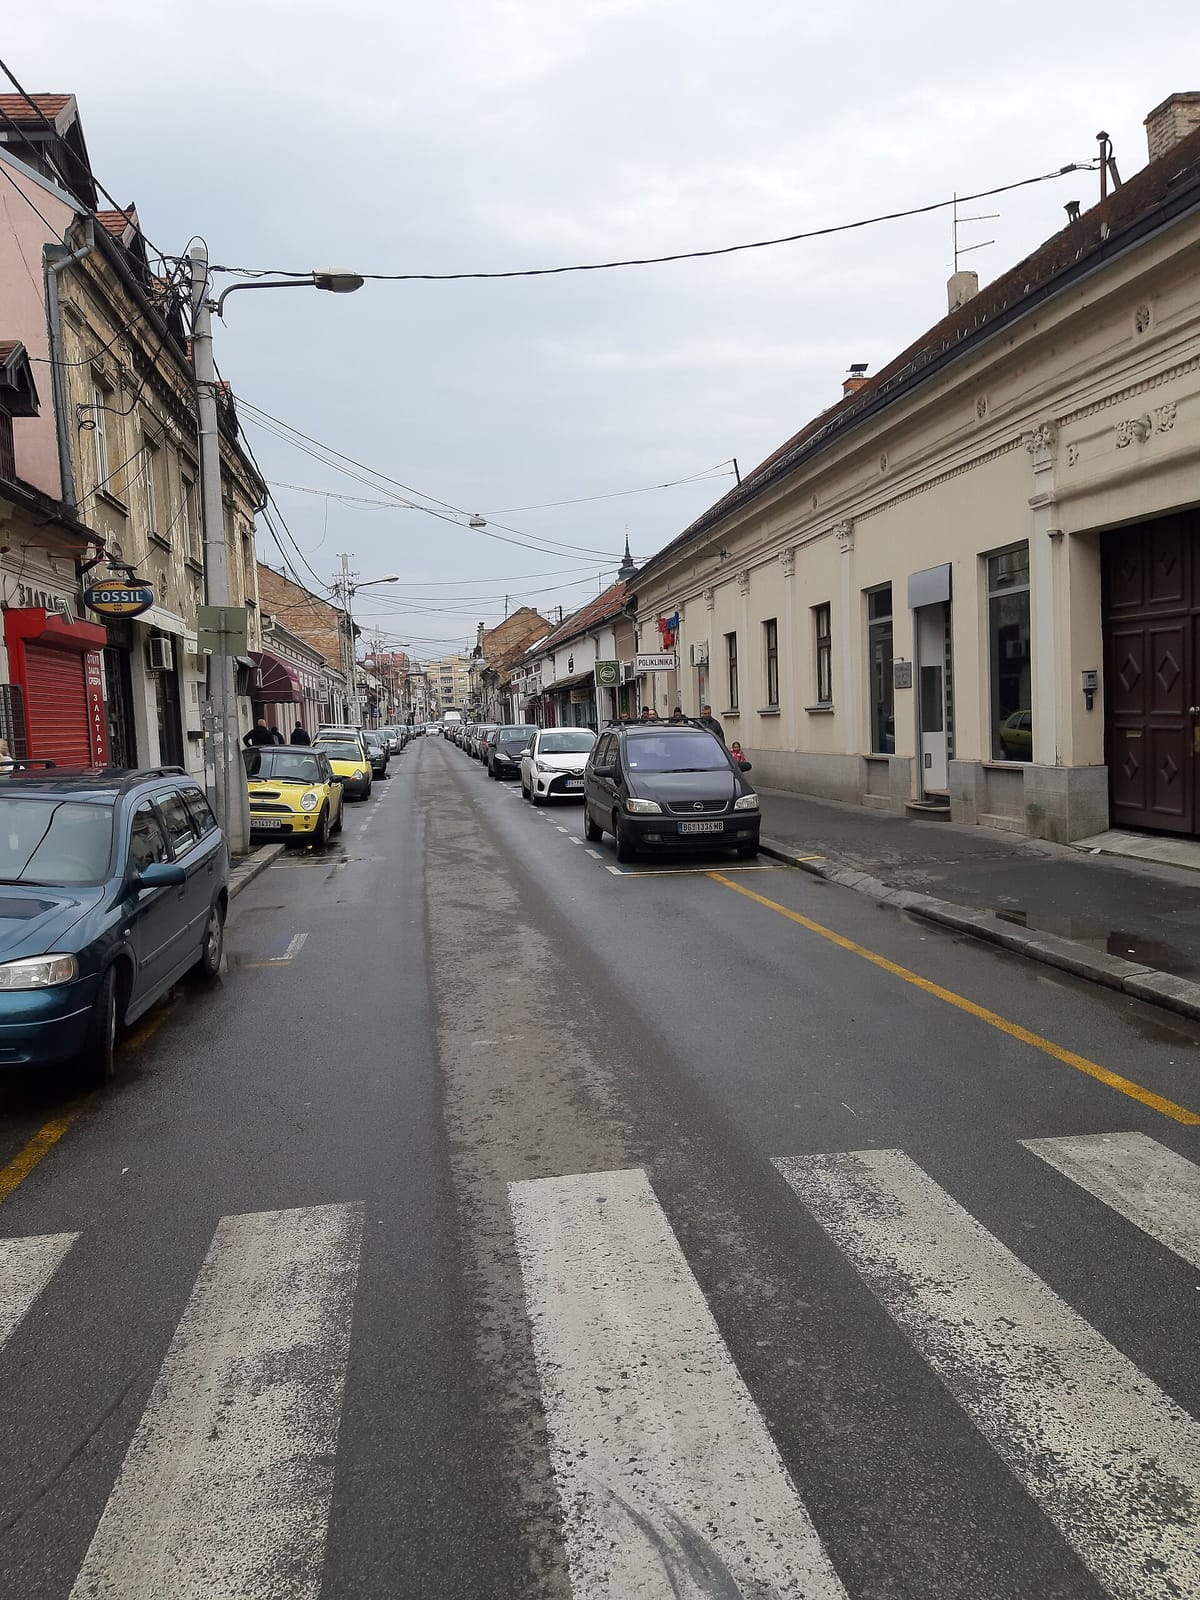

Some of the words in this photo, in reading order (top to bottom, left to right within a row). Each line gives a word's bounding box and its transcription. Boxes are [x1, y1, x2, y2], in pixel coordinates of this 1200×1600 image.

[92, 591, 143, 602] FOSSIL
[638, 658, 673, 667] POLIKLINIKA
[93, 694, 103, 755] ЗЛАТАР
